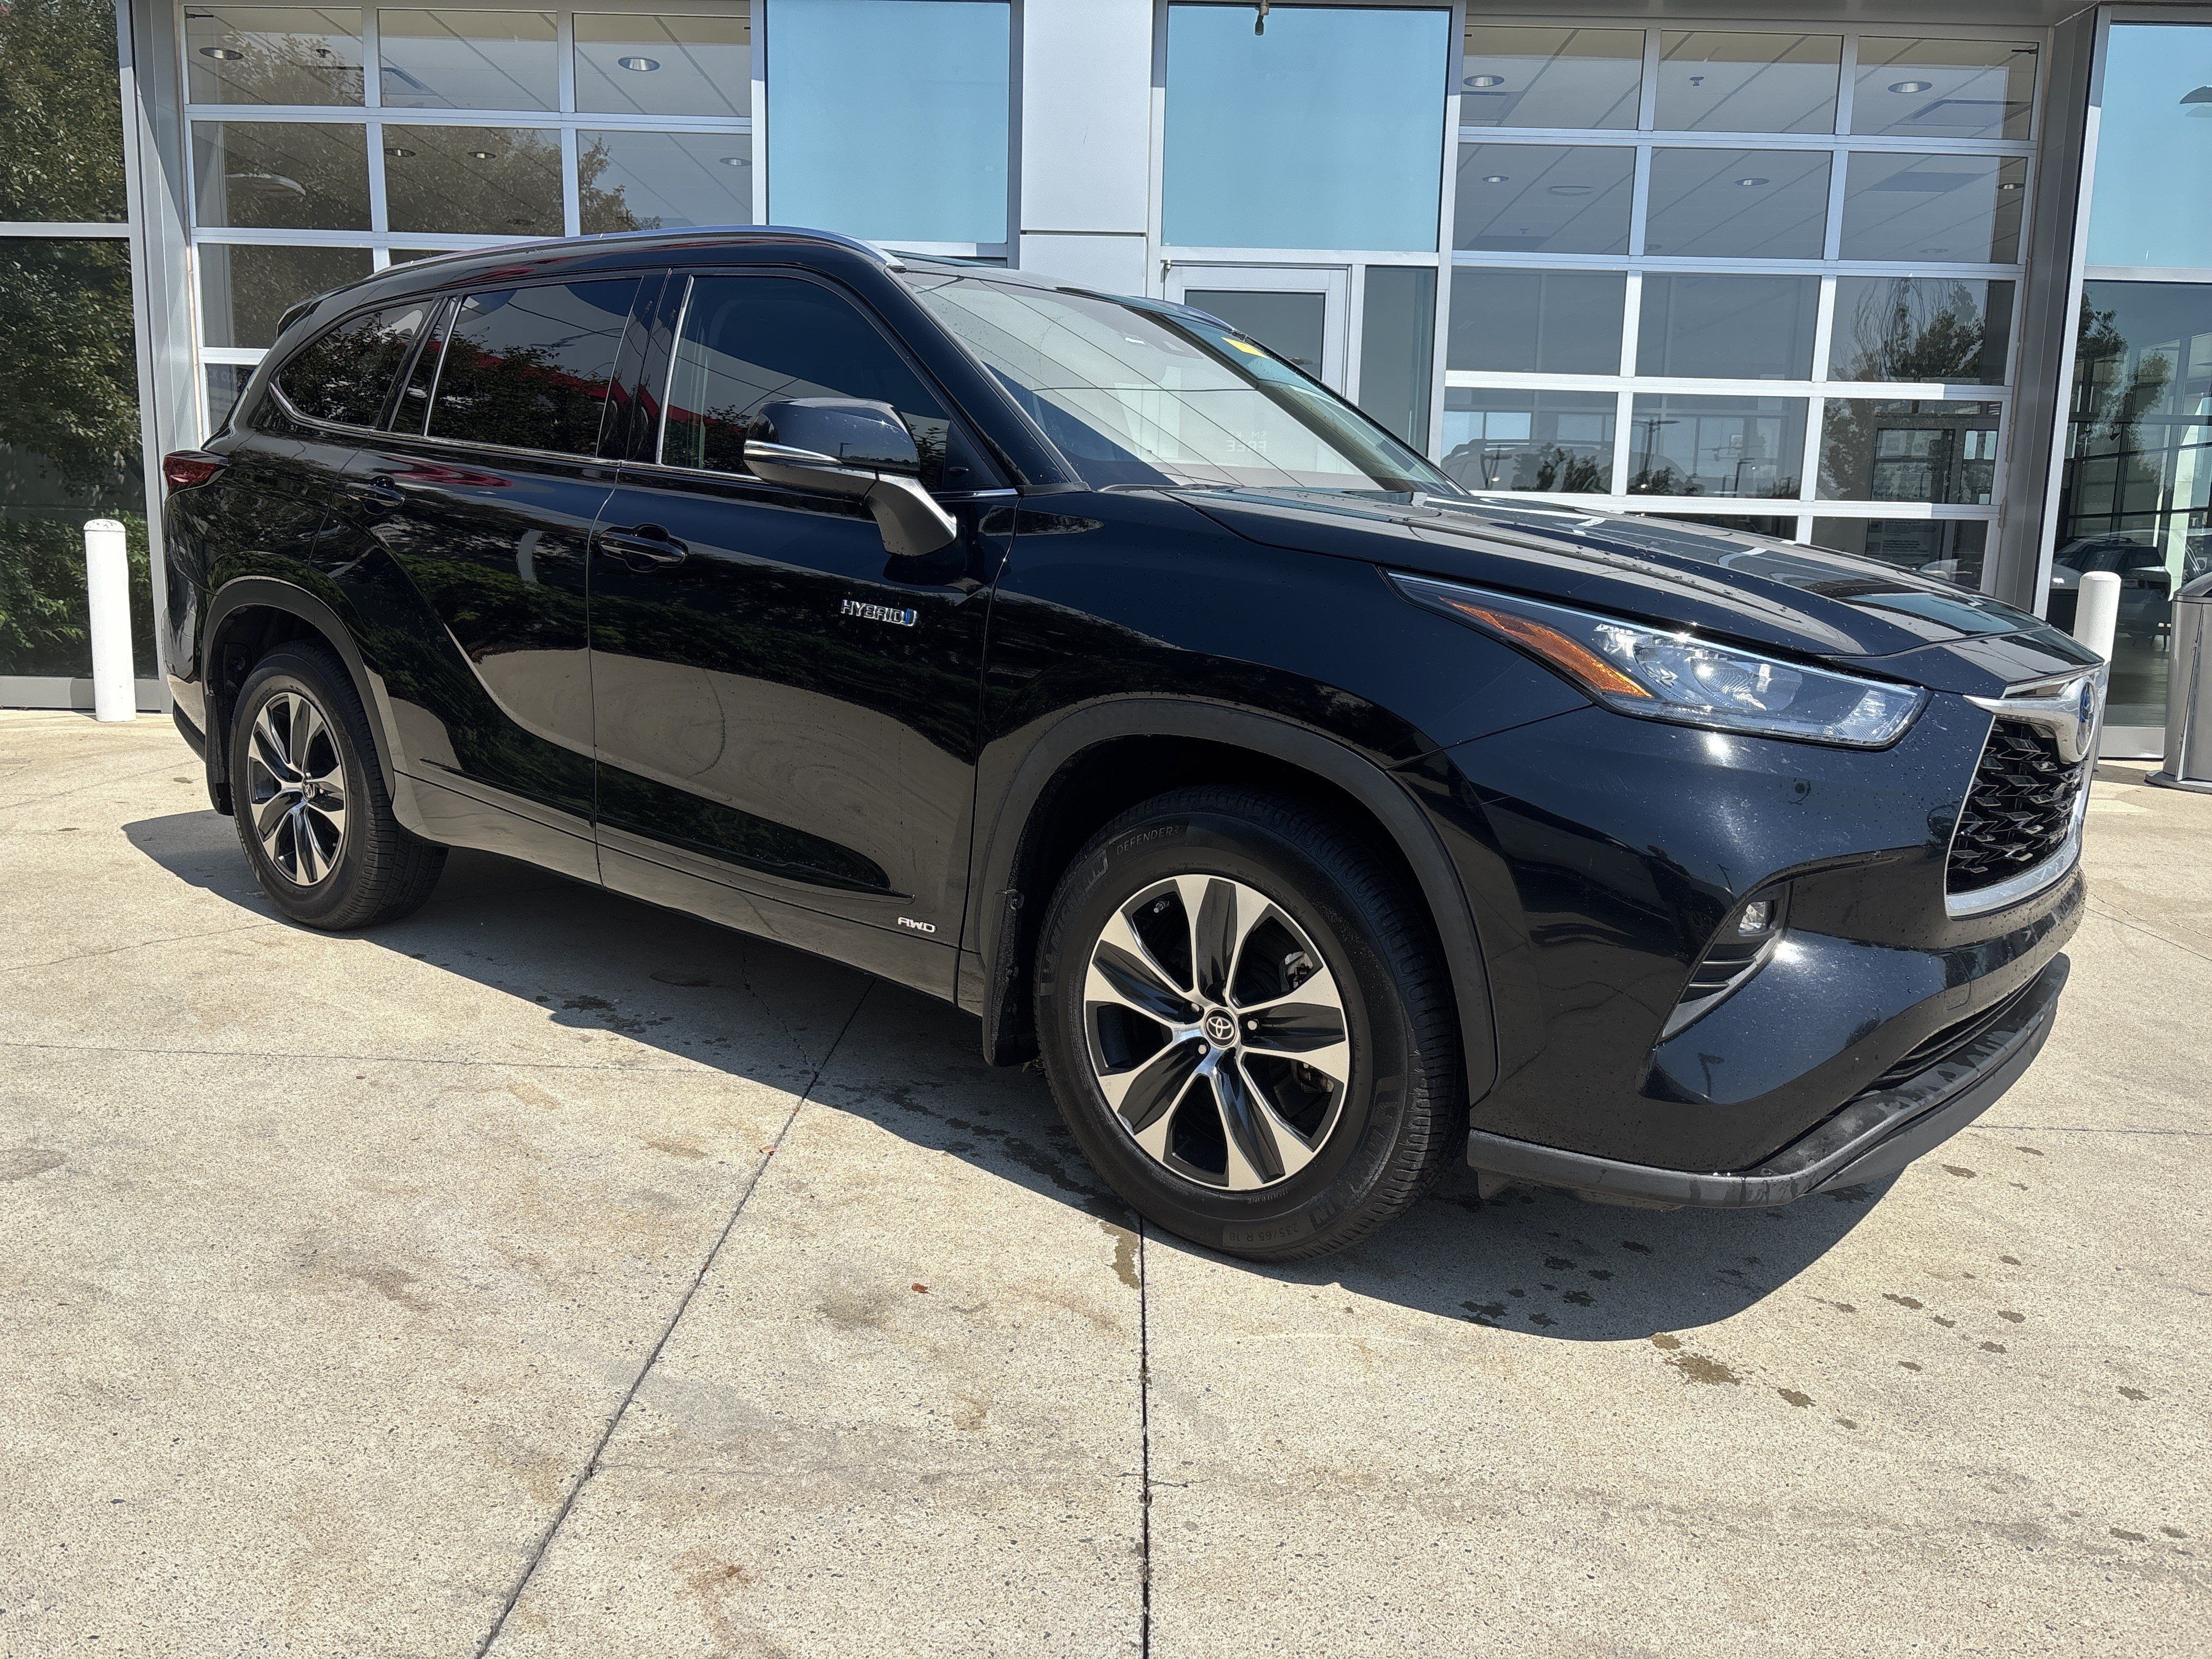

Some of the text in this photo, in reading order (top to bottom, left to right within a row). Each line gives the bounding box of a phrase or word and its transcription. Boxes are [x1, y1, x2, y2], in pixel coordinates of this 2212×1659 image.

[840, 599, 917, 627] HYBRID
[898, 917, 935, 933] AWD
[1228, 1222, 1300, 1242] 235/65 R 18
